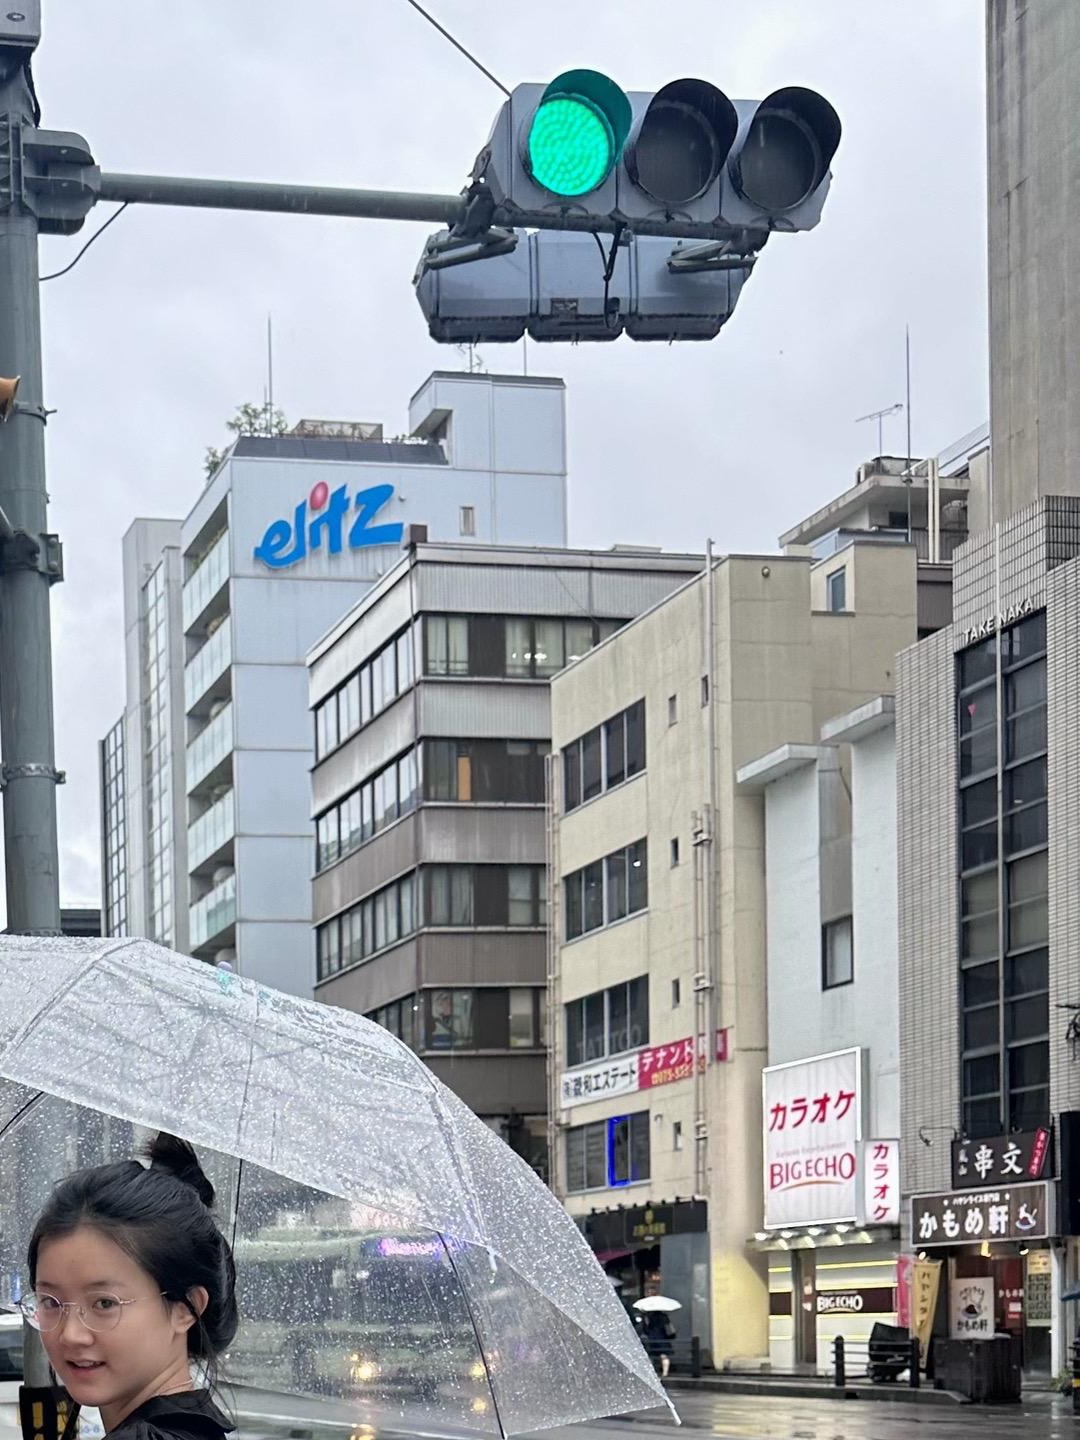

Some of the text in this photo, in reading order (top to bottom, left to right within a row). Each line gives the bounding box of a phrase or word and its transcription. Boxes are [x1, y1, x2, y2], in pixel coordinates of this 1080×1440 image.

[254, 481, 404, 568] elitz
[769, 1090, 856, 1132] カラオケ
[770, 1152, 856, 1190] BIG ECHO
[873, 1143, 890, 1221] カラオケ
[919, 1204, 1009, 1239] かもめ軒
